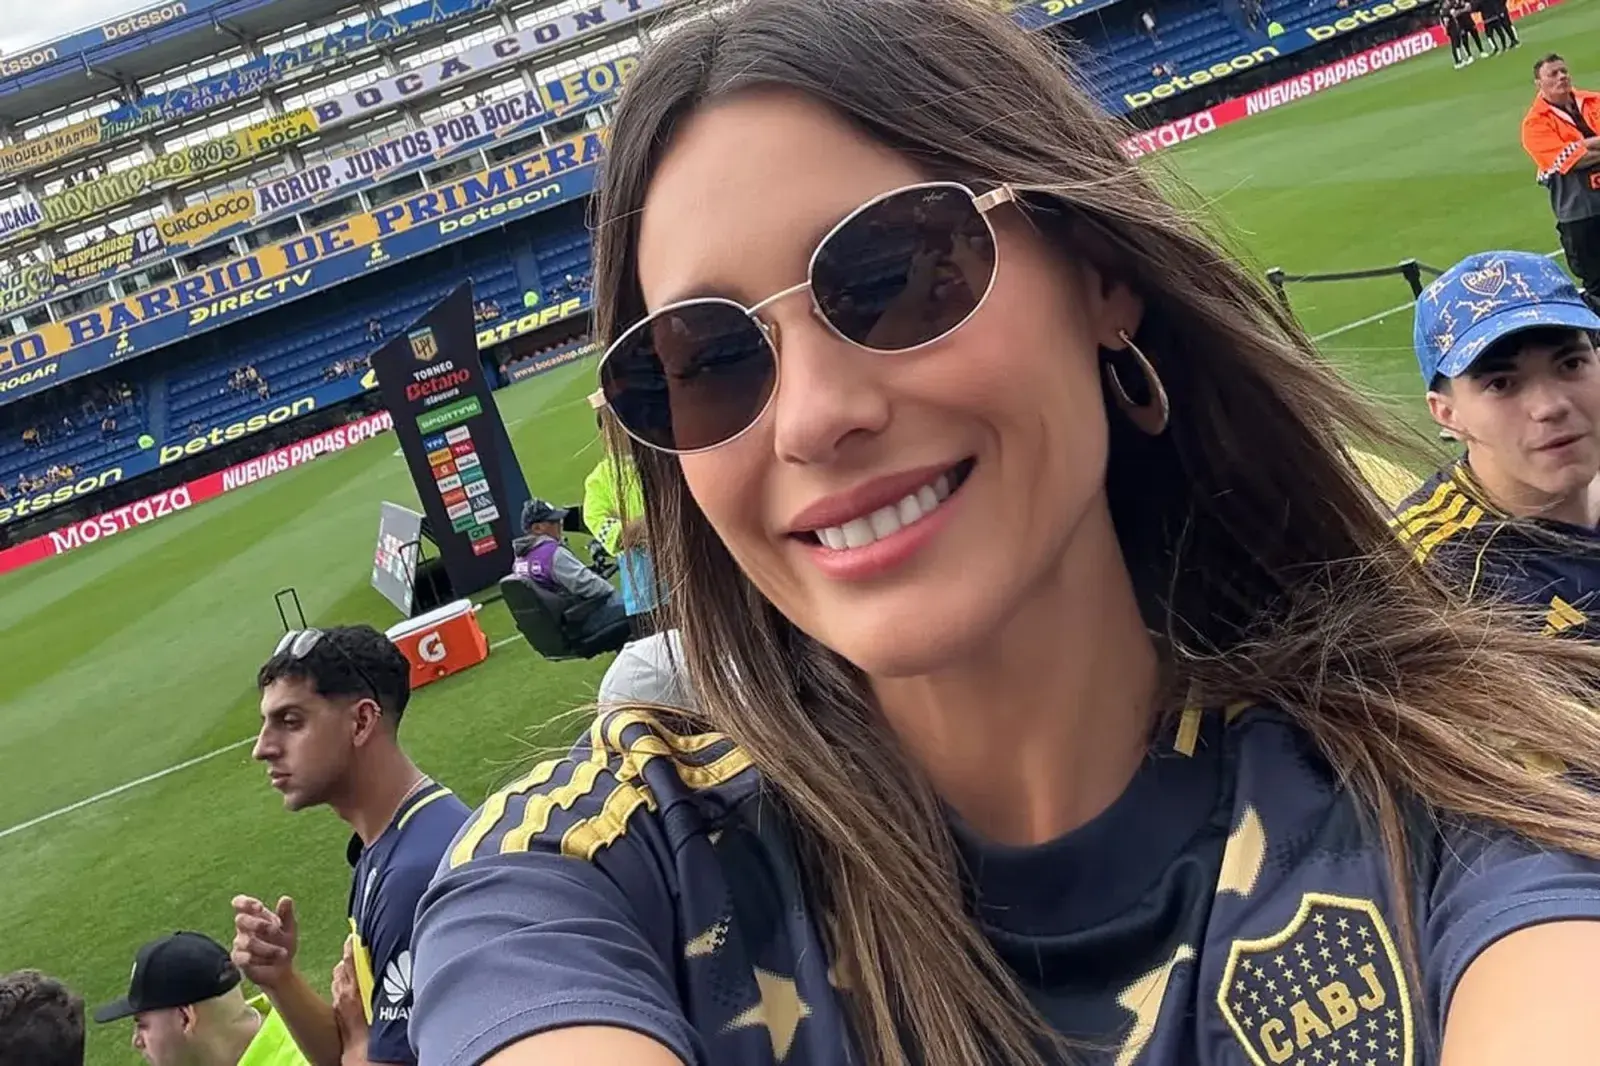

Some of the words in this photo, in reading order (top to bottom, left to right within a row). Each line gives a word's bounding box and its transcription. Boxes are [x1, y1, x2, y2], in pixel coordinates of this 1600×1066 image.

[102, 3, 188, 41] betsson
[315, 56, 471, 124] BOCA
[1125, 45, 1280, 109] betsson
[1247, 73, 1311, 116] NUEVAS
[1312, 55, 1369, 93] PAPAS
[1370, 31, 1438, 71] COATED.
[55, 124, 98, 149] MARTIN
[188, 138, 242, 172] 805
[258, 123, 312, 150] BOCA
[345, 131, 432, 180] JUNTOS
[436, 117, 481, 147] POR
[481, 90, 543, 131] BOCA
[162, 195, 250, 239] CIRCOLOCO
[439, 182, 562, 235] betsson
[64, 256, 262, 348] BARRIO
[281, 222, 354, 268] DE
[373, 133, 605, 237] PRIMERA
[136, 226, 160, 253] 12
[188, 269, 313, 327] DIRECTV
[405, 368, 471, 401] Betano
[412, 360, 454, 382] TORNEO
[160, 396, 316, 465] betsson
[222, 450, 290, 492] NUEVAS
[291, 428, 347, 466] PAPAS
[418, 631, 447, 663] G
[1260, 962, 1386, 1064] CABJ
